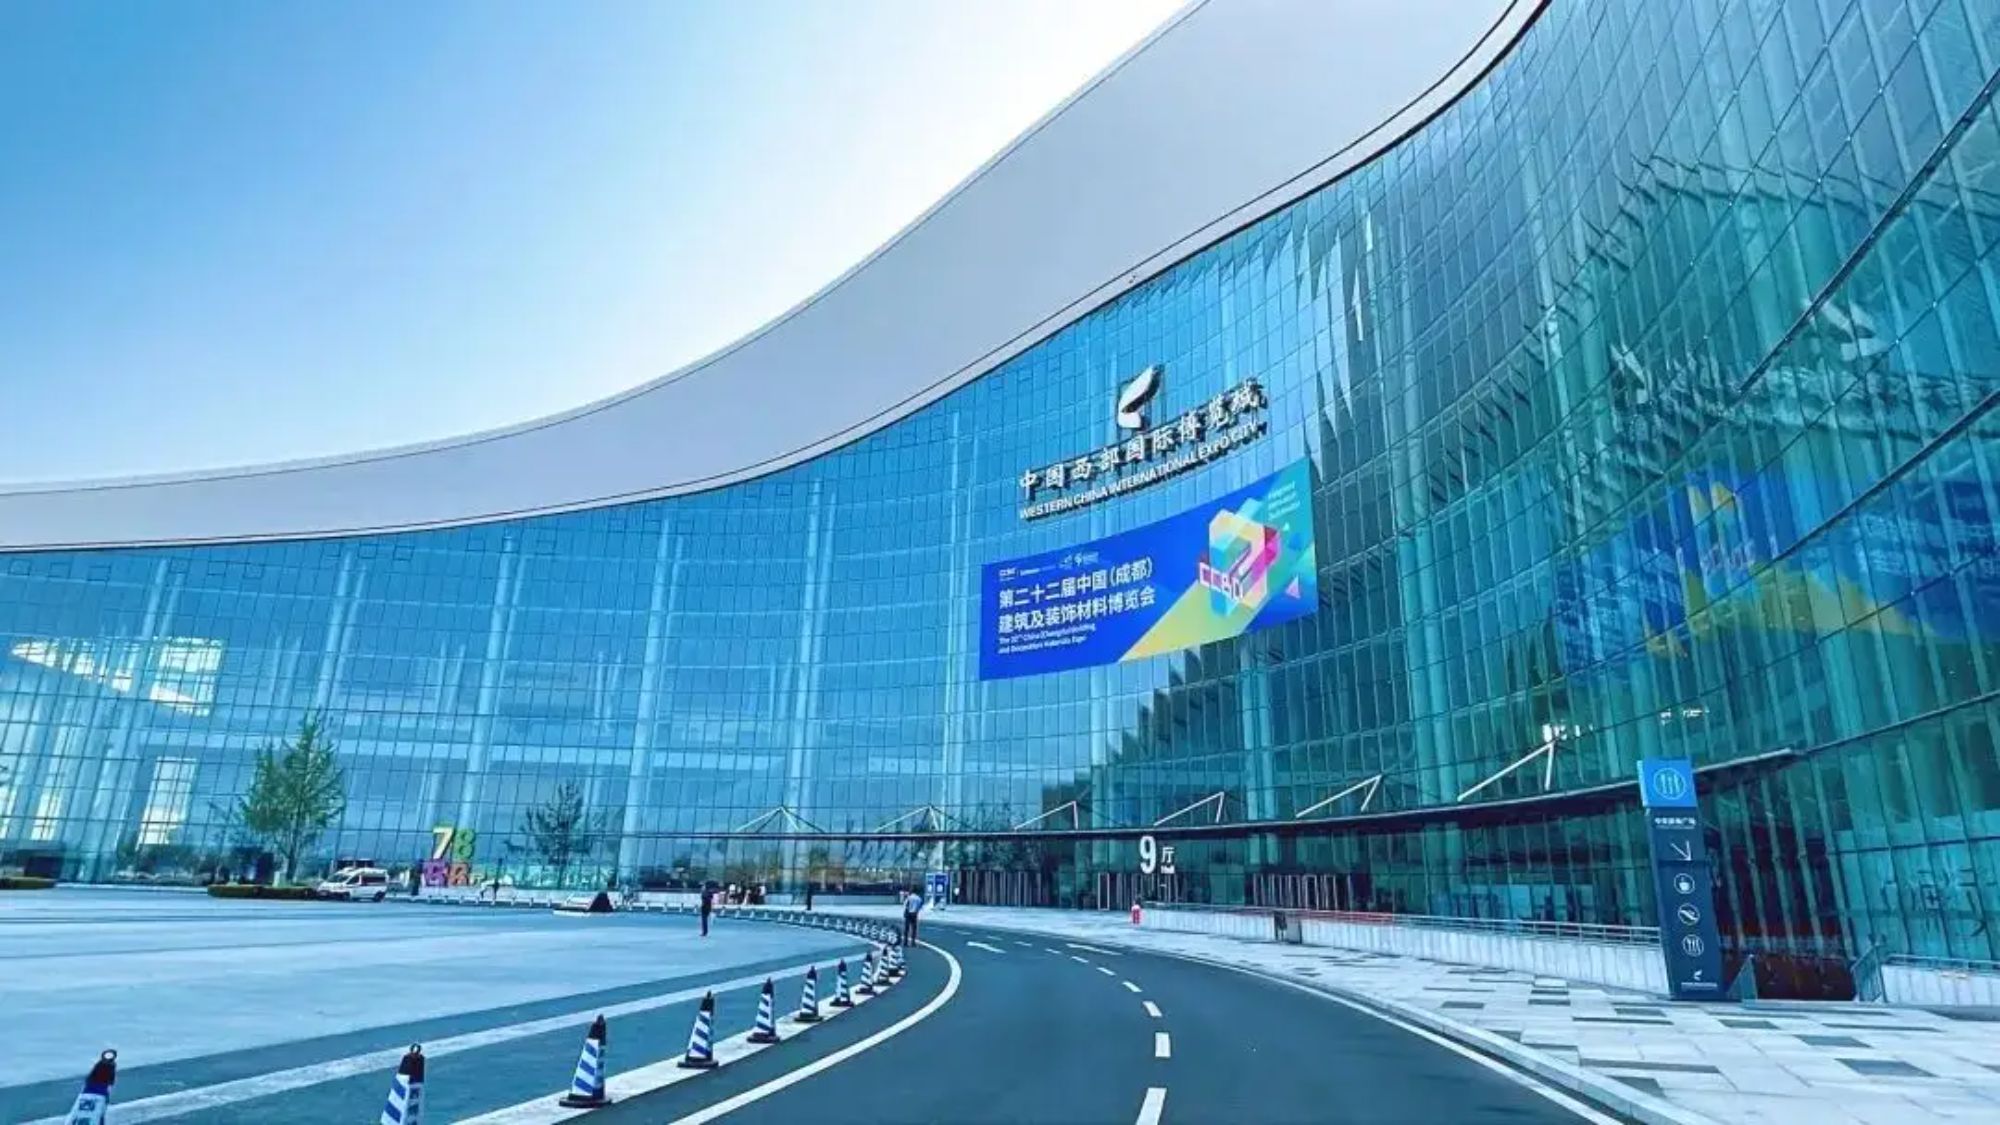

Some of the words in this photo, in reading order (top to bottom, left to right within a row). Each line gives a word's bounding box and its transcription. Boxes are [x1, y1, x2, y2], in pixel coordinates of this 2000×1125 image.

[1020, 379, 1266, 499] 中国西部国际博览城
[1020, 498, 1073, 518] WESTERN
[1074, 486, 1107, 506] CHINA
[1108, 452, 1197, 494] INTERNATIONAL
[1198, 436, 1230, 460] EXPO
[998, 585, 1156, 634] 建筑及装饰材料博览会
[1140, 836, 1156, 874] 9
[1161, 846, 1175, 863] 厅
